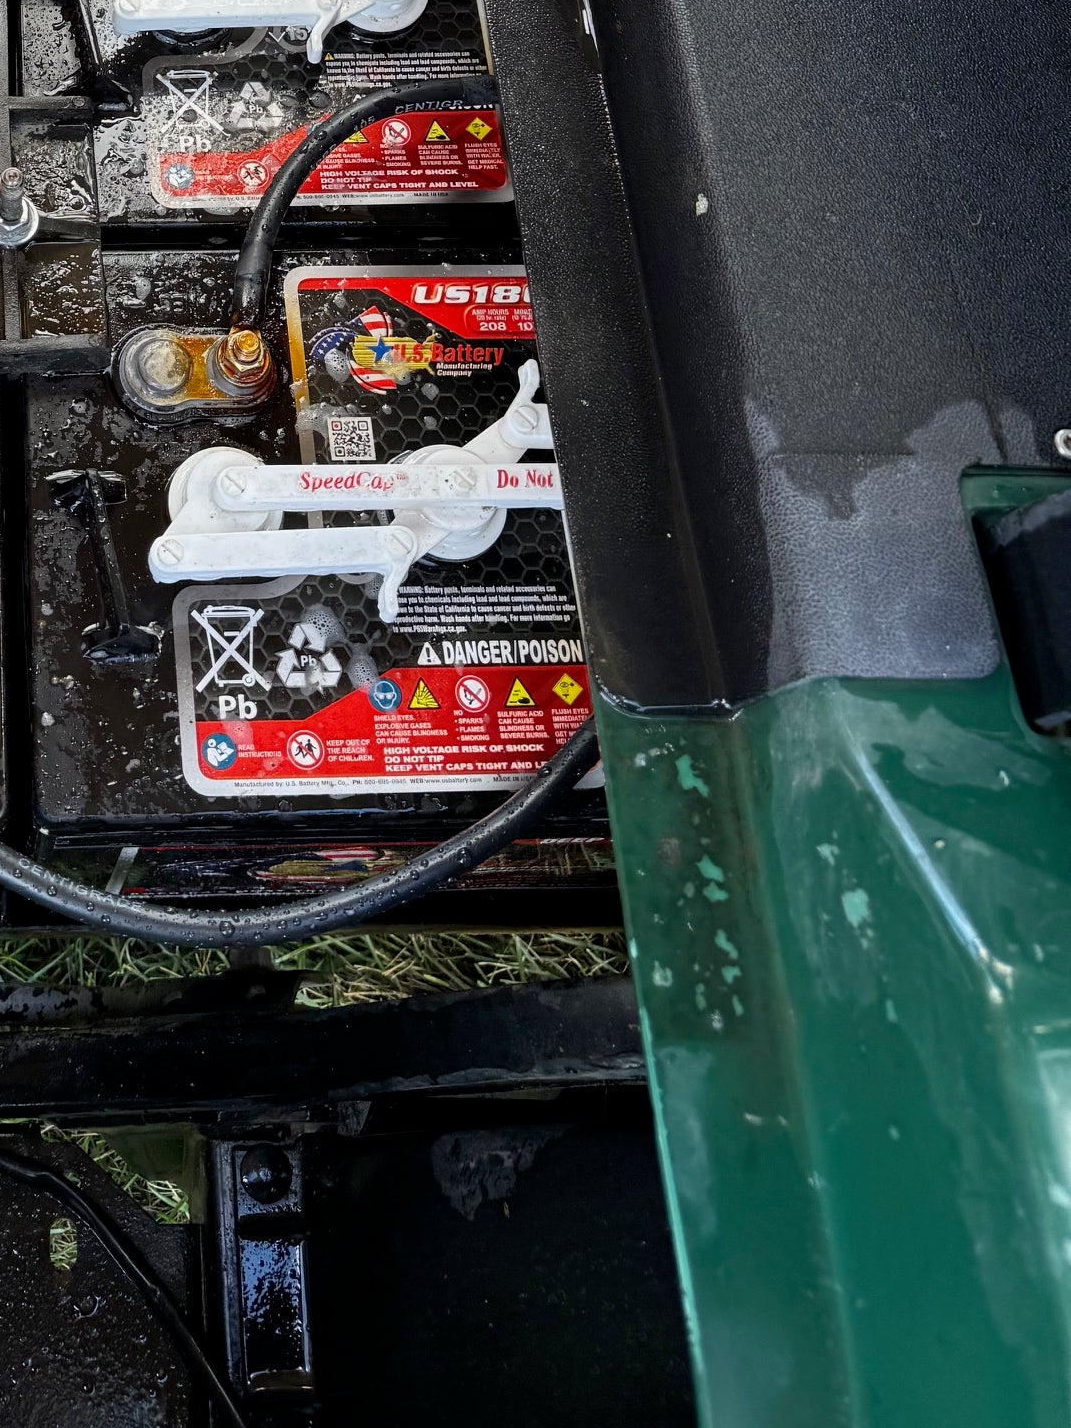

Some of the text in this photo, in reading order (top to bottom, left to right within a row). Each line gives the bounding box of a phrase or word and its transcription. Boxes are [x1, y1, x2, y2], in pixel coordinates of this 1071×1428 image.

[287, 27, 308, 41] 15
[479, 323, 507, 331] 208
[430, 344, 504, 366] Battery
[436, 363, 492, 371] Manufacturing
[437, 369, 472, 377] Company
[497, 469, 519, 489] Do
[525, 469, 554, 489] Not
[441, 639, 584, 664] DANGER/POISON
[301, 654, 317, 667] Pb
[218, 694, 258, 720] Pb
[386, 764, 413, 772] KEEP
[415, 763, 443, 771] VENT
[476, 762, 508, 770] TIGHT
[511, 761, 535, 769] AND
